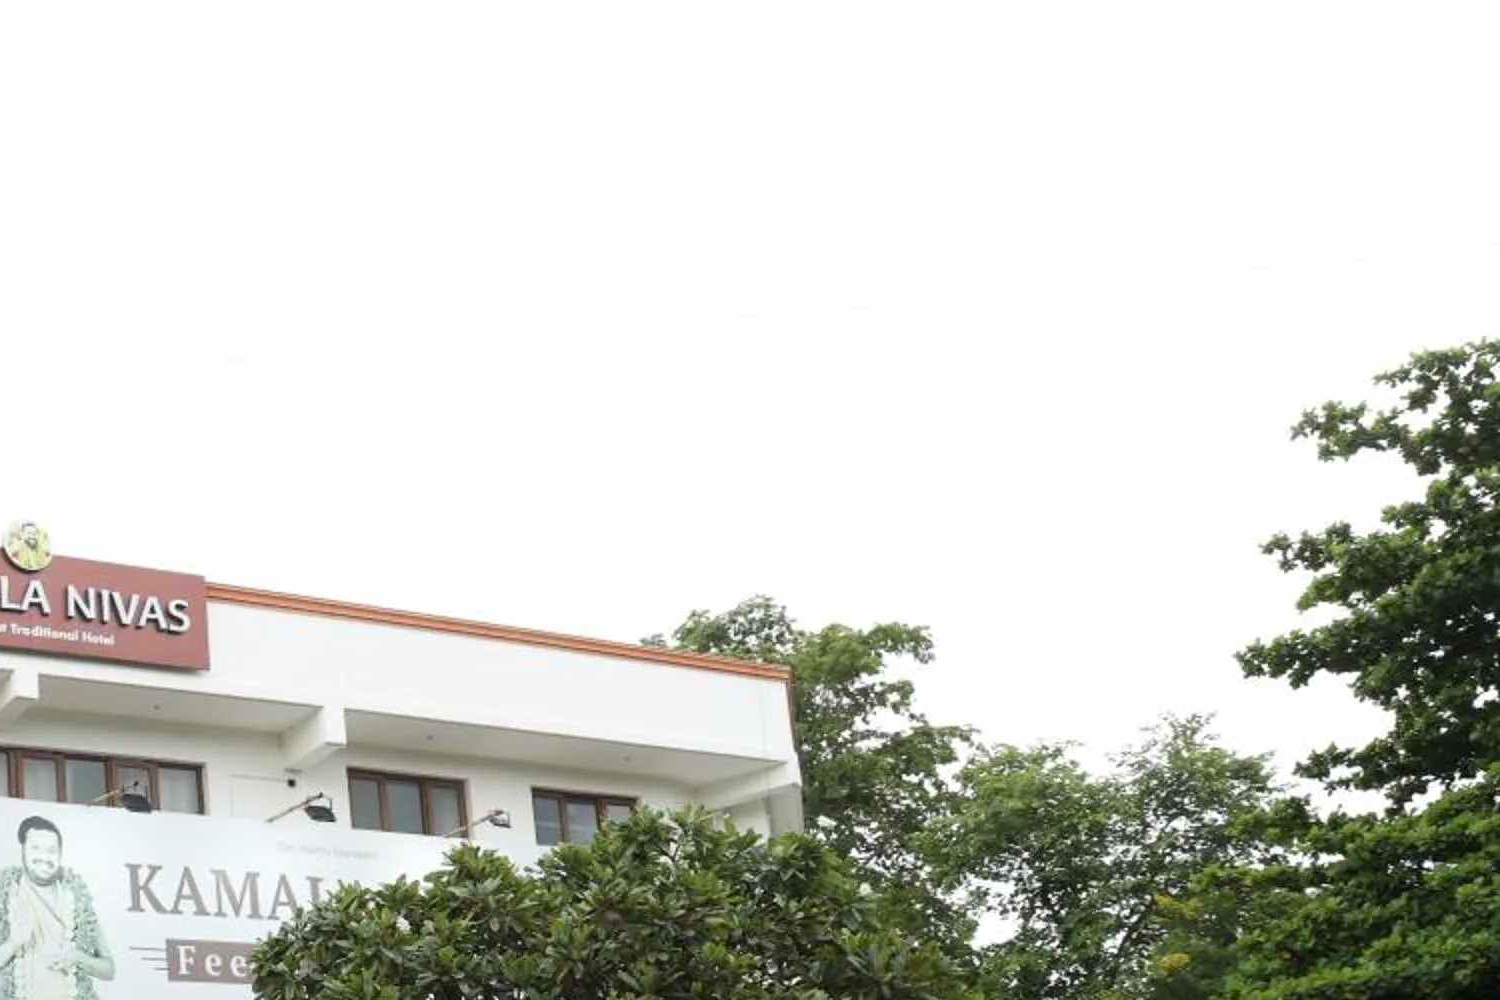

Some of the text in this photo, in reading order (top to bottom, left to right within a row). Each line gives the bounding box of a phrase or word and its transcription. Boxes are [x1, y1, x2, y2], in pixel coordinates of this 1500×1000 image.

[67, 583, 191, 633] NIVAS
[10, 623, 79, 642] Traditional
[81, 631, 115, 646] Hotel
